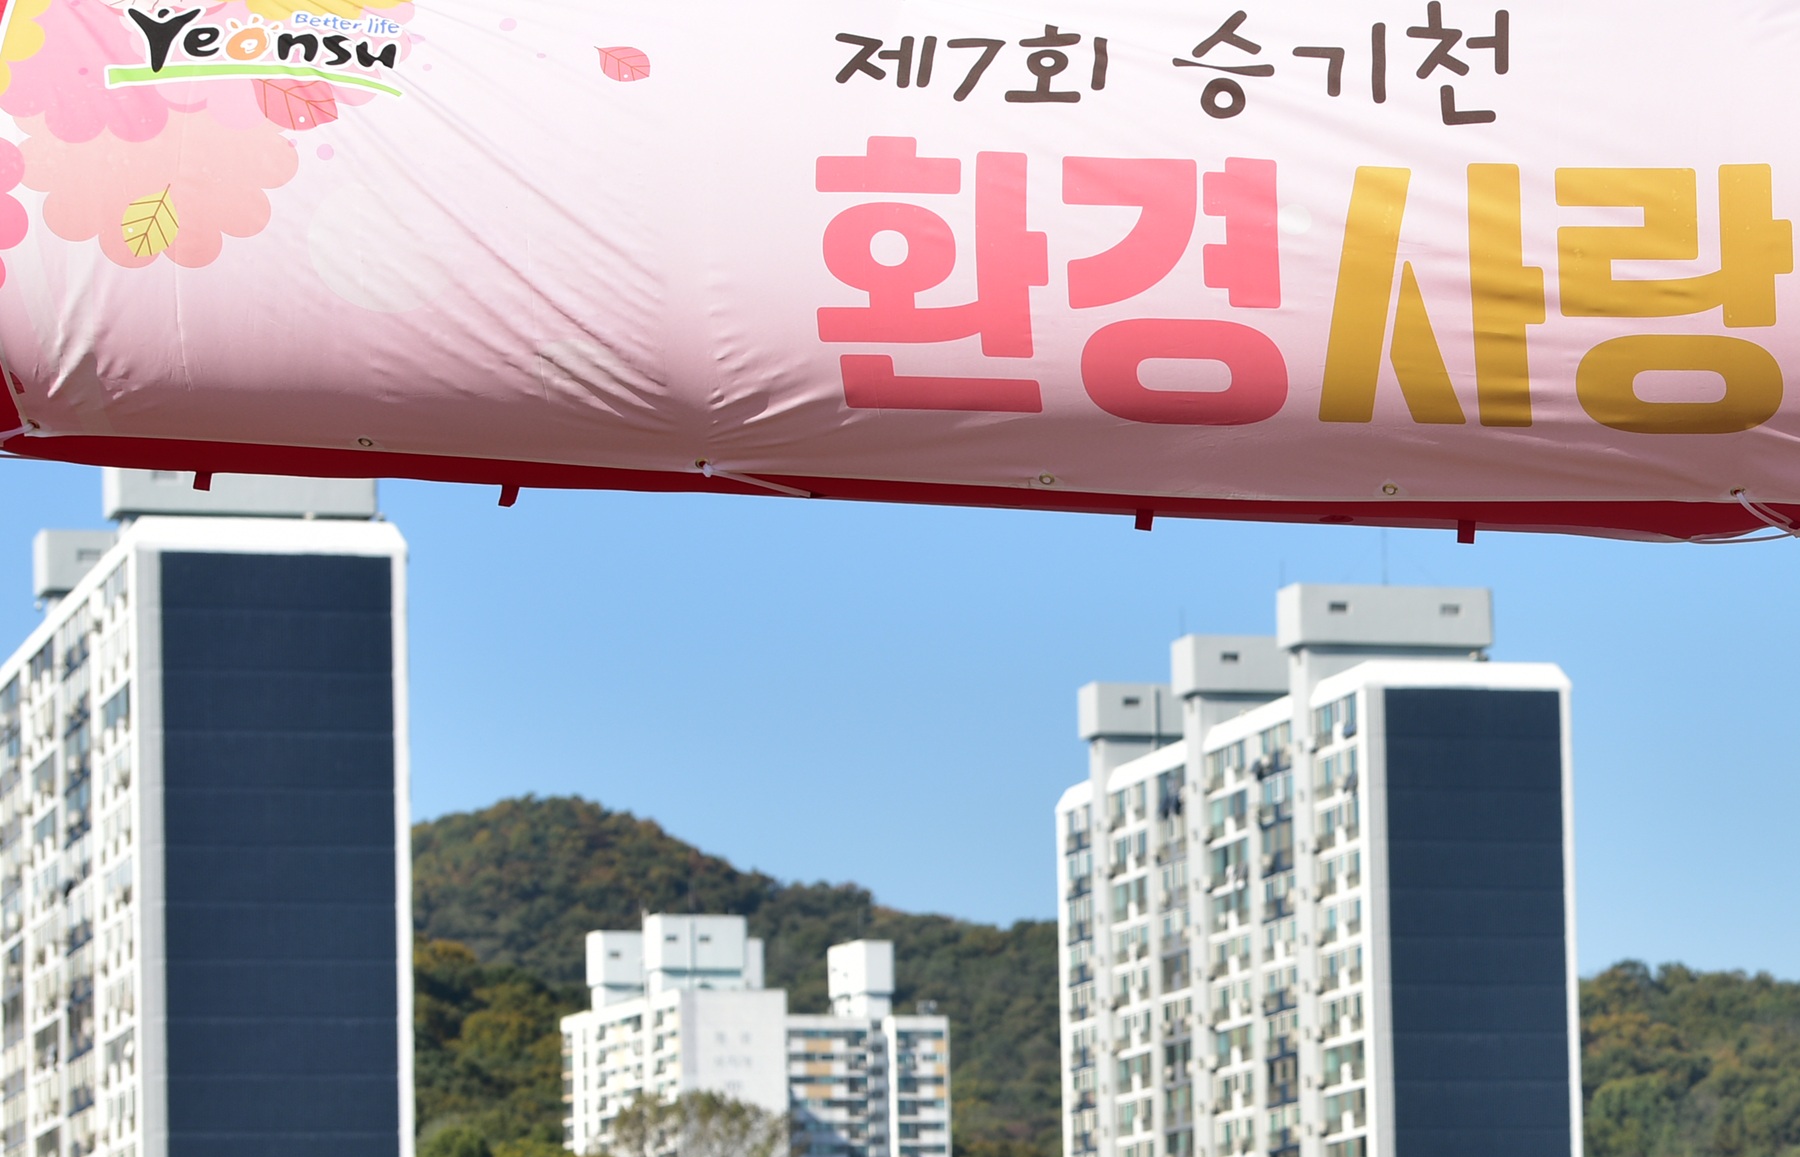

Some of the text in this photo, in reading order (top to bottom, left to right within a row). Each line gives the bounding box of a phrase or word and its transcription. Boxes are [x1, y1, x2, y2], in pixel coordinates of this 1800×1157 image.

[128, 8, 397, 73] Yeonsu
[295, 13, 400, 34] Better life
[834, 9, 1510, 126] 제7회 승기천
[815, 136, 1793, 434] 환경사랑
